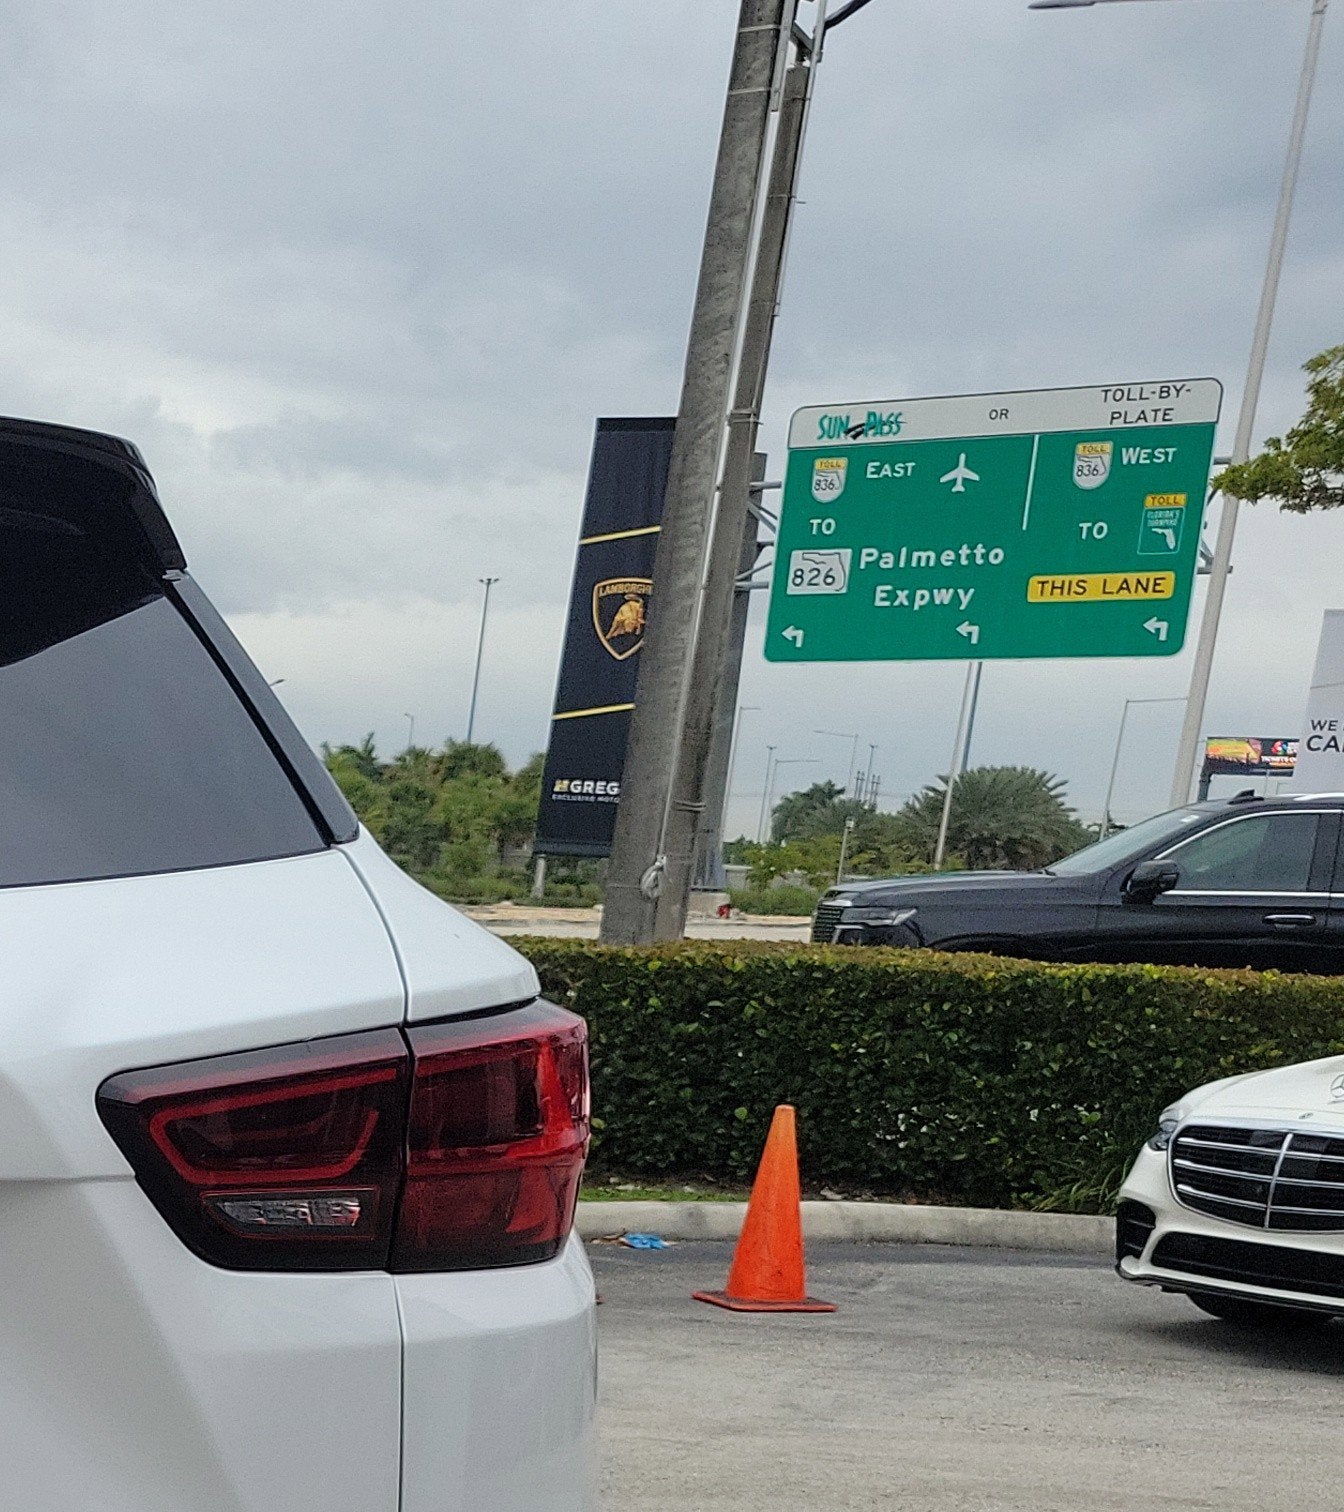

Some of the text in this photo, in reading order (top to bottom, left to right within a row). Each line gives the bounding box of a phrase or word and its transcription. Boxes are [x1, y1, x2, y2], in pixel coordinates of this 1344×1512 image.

[1101, 384, 1191, 403] TOLL-BY-
[989, 408, 1010, 420] OR
[1109, 407, 1174, 425] PLATE
[817, 410, 905, 440] SUN PASS
[1081, 445, 1105, 454] TOLL
[1121, 447, 1178, 466] WEST
[819, 460, 842, 469] TOLL
[866, 462, 916, 479] EAST
[1076, 465, 1099, 477] 836
[813, 479, 835, 492] 836
[1151, 496, 1181, 506] TOLL
[809, 518, 836, 535] TO
[1079, 521, 1109, 540] TO
[859, 542, 1006, 570] Palmetto
[791, 567, 836, 587] 826
[1037, 576, 1167, 597] THIS LANE
[874, 584, 976, 611] Expwy
[1310, 719, 1339, 732] WE
[1306, 734, 1344, 753] CA
